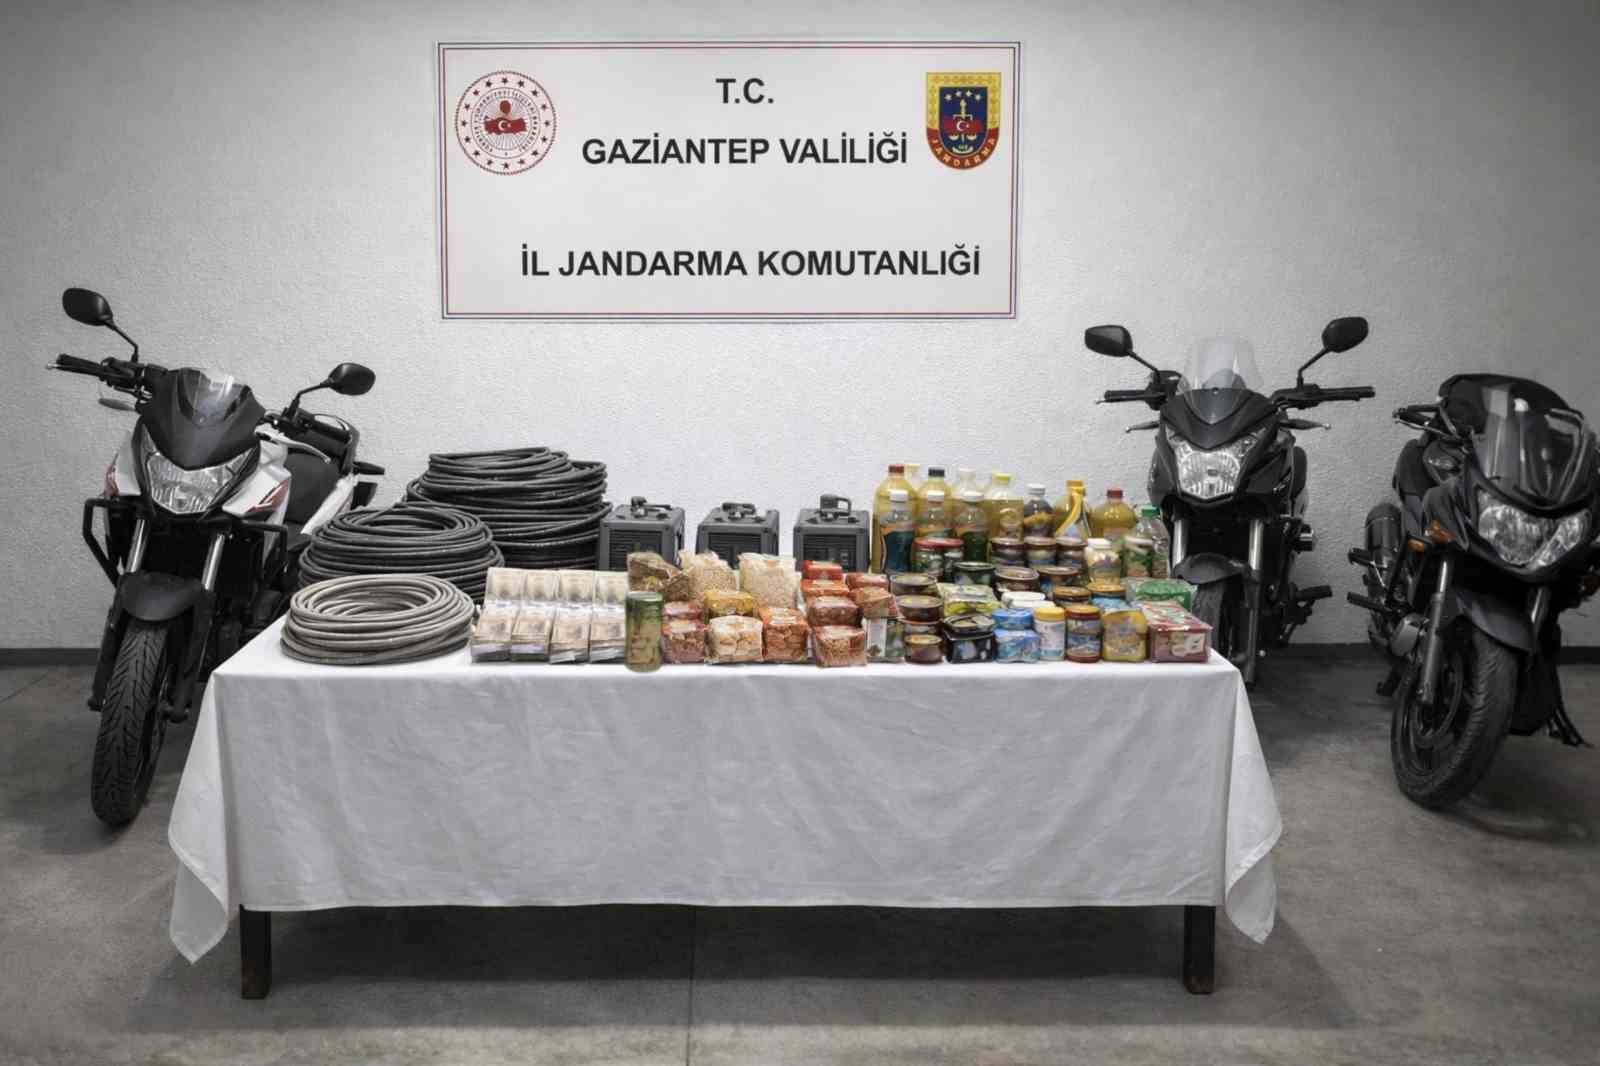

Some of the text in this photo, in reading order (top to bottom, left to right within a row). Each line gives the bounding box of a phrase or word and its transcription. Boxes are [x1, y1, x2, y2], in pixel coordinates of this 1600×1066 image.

[715, 77, 774, 105] T.C.
[582, 131, 907, 165] GAZİANTEP VALİLİĞİ
[521, 243, 550, 276] İL
[558, 250, 748, 277] JANDARMA
